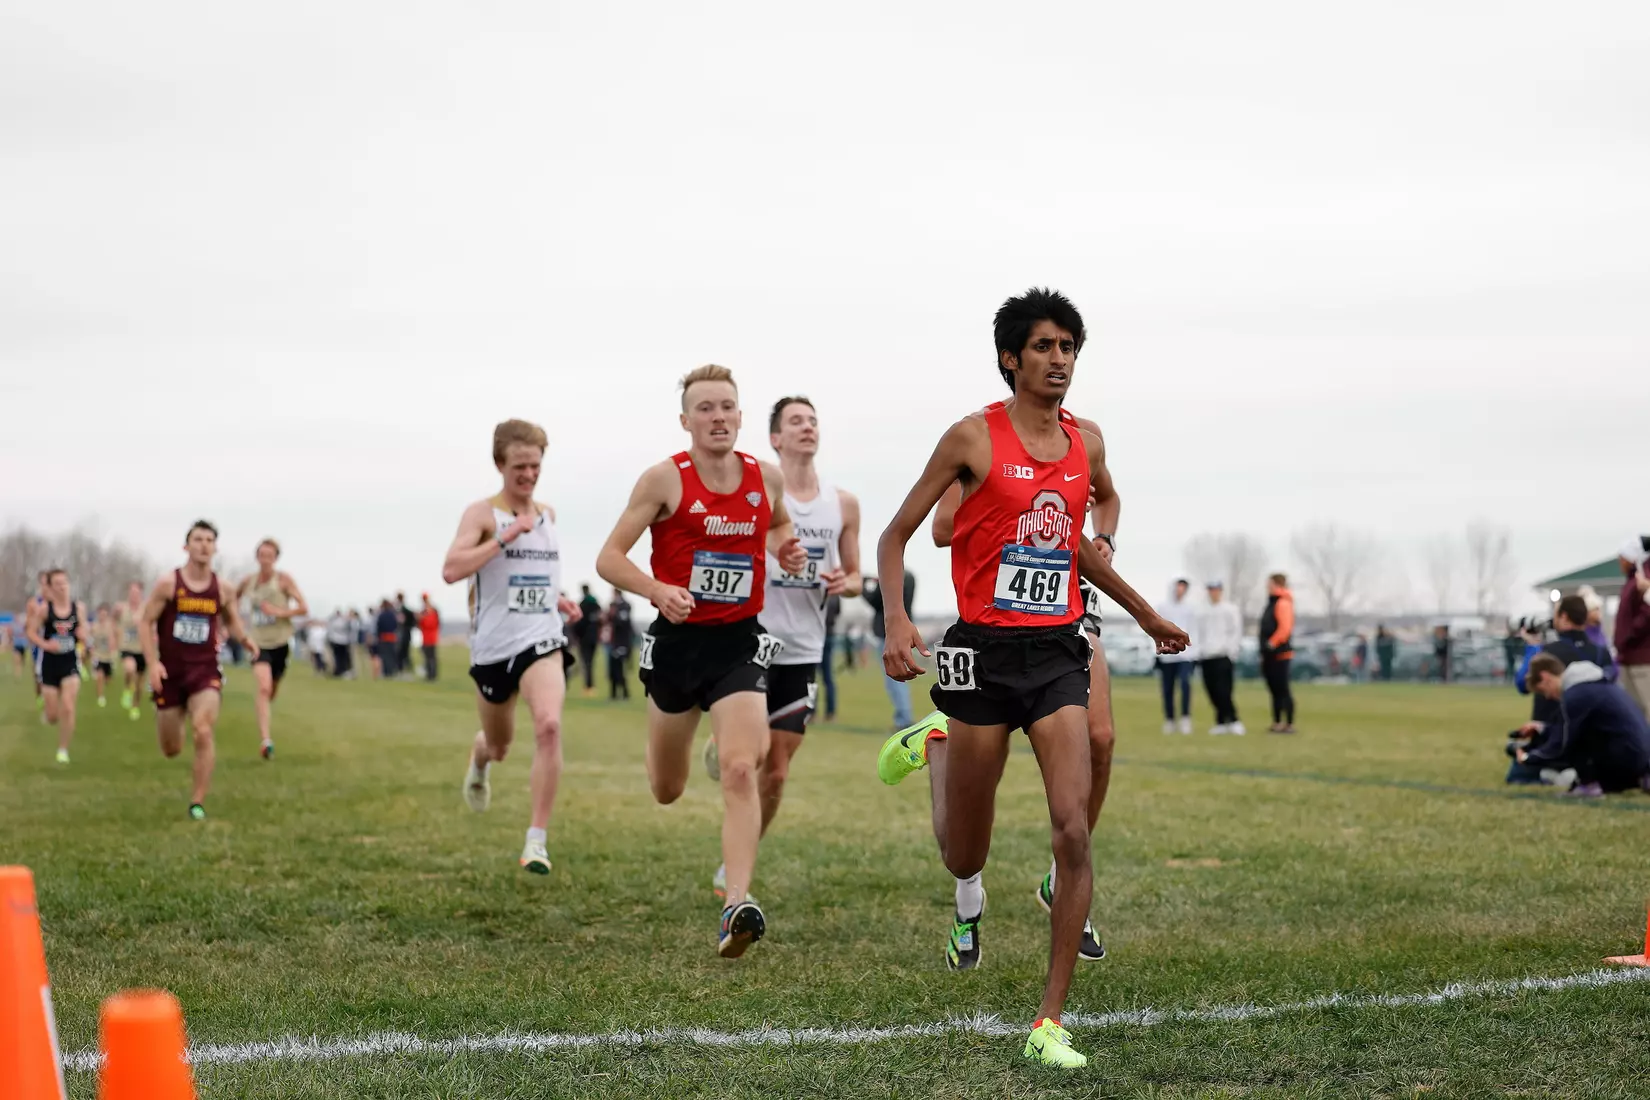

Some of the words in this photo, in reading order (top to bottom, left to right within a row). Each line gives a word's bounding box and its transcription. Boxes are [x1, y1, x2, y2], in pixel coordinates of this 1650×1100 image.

[704, 514, 757, 536] Miami
[1016, 510, 1043, 545] OHIO
[1043, 506, 1073, 549] STATE
[700, 568, 744, 595] 397
[1008, 568, 1061, 603] 469
[516, 589, 547, 608] 492
[758, 636, 785, 662] 39
[937, 651, 970, 686] 69
